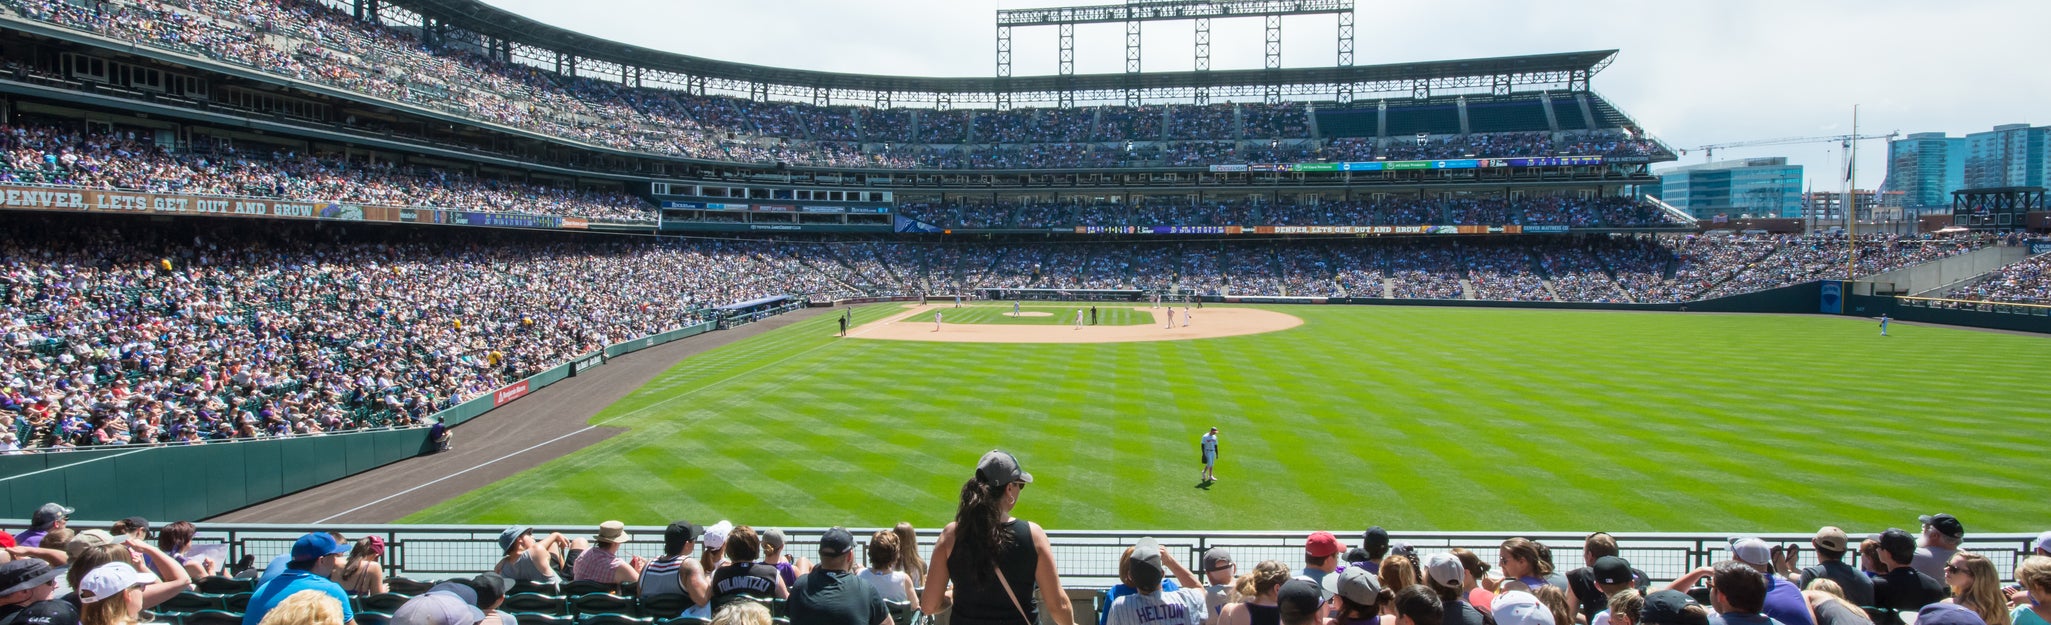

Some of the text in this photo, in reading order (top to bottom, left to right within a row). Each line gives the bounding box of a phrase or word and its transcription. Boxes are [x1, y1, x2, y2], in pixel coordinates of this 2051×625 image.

[97, 194, 147, 210] LETS
[154, 197, 188, 212] GET
[197, 200, 229, 213] OUT
[235, 202, 267, 215] AND
[273, 204, 313, 217] GROW
[717, 575, 771, 594] TULOWITZKI
[1136, 603, 1185, 624] HELTON
